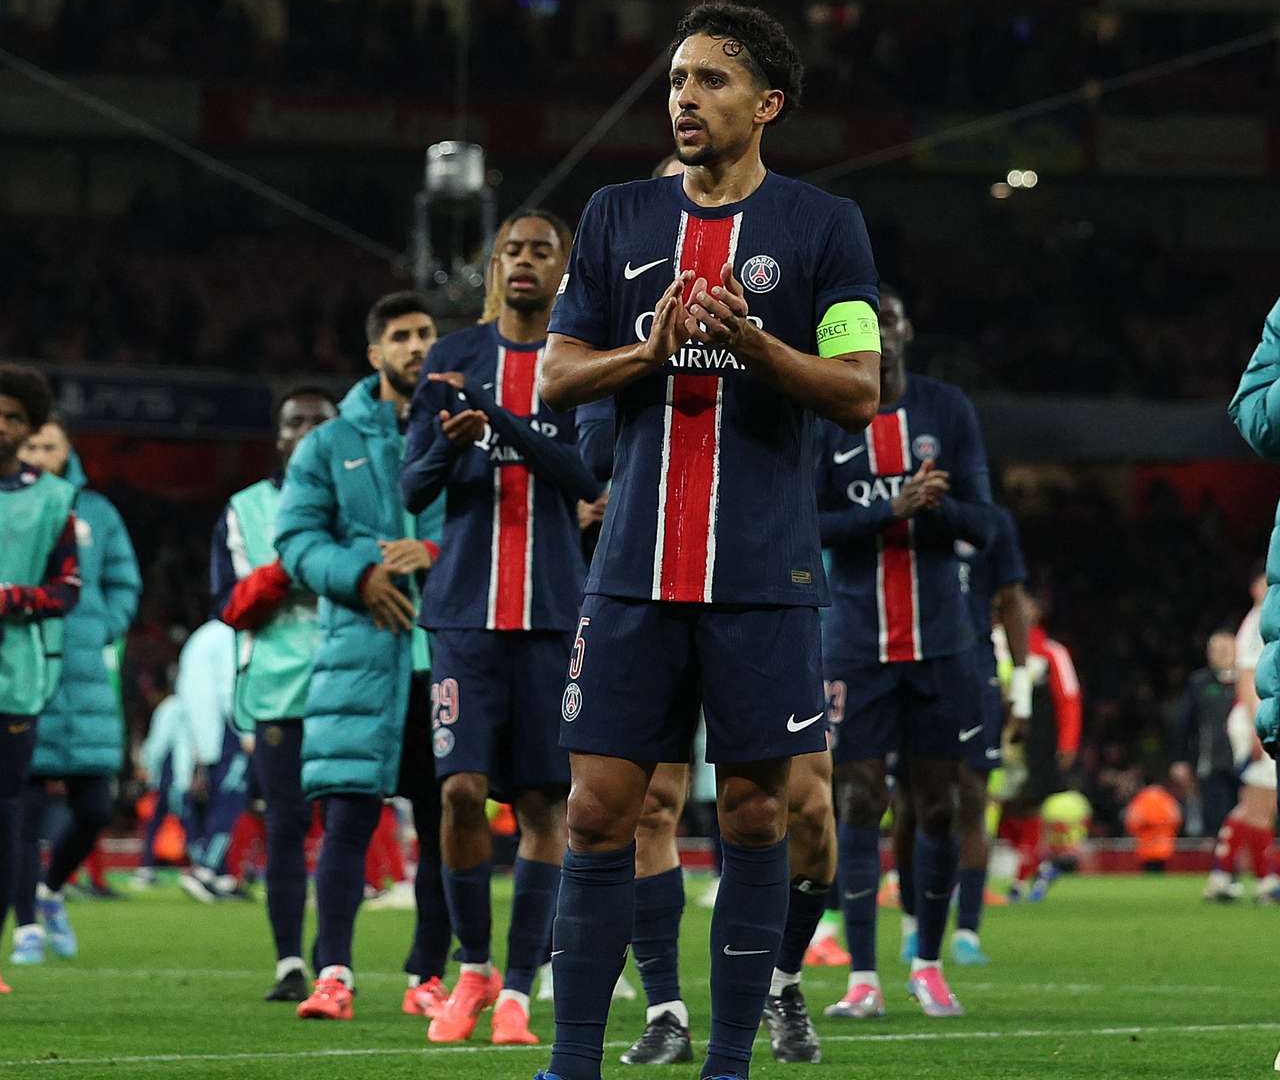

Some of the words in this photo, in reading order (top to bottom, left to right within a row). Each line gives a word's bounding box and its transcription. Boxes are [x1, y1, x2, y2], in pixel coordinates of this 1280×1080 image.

[817, 323, 847, 340] SPECT
[846, 475, 912, 508] QAT
[569, 617, 591, 679] 5
